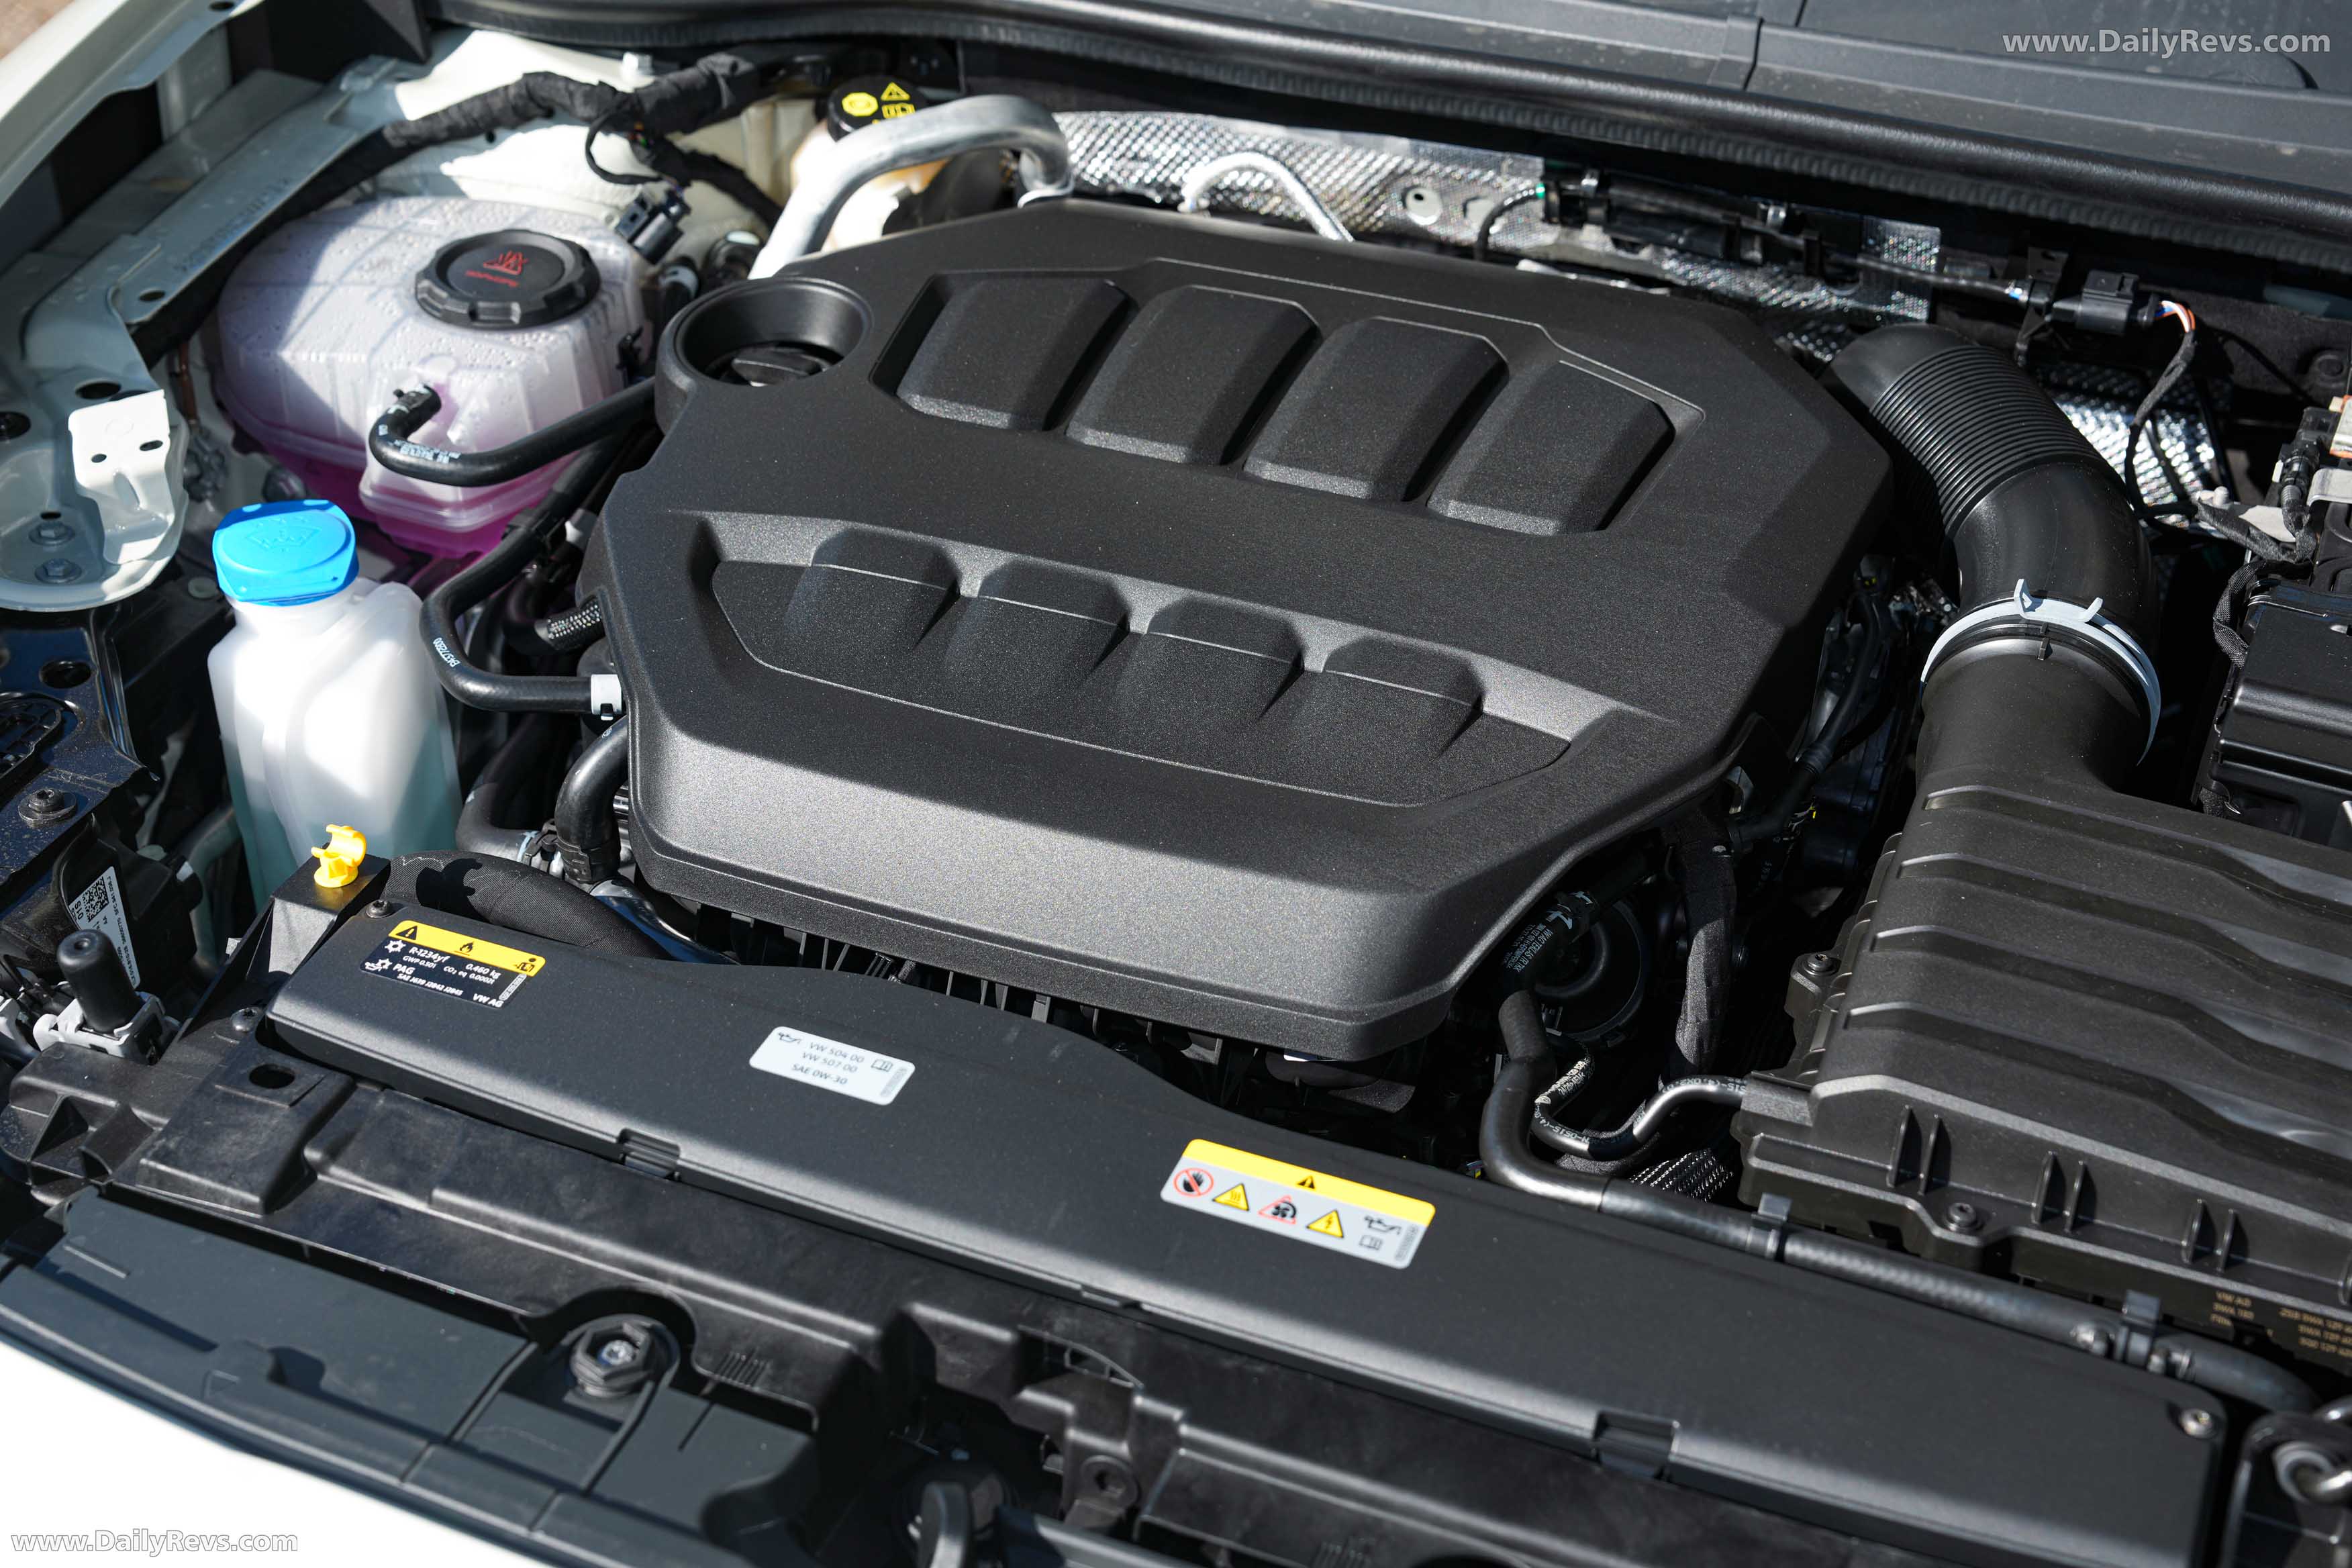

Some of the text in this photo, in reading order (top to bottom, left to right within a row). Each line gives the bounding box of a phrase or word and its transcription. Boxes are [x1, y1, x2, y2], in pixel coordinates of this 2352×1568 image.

[403, 955, 420, 963] GWP
[409, 946, 450, 963] R-1234yf
[393, 963, 415, 975] PAG
[466, 963, 501, 979] 0.460 kg
[397, 973, 411, 982] SAE
[473, 993, 504, 1008] VW AG
[810, 1042, 865, 1063] VW 504 00
[802, 1052, 859, 1073] VW 507 00
[792, 1064, 848, 1085] SAE 0W-30
